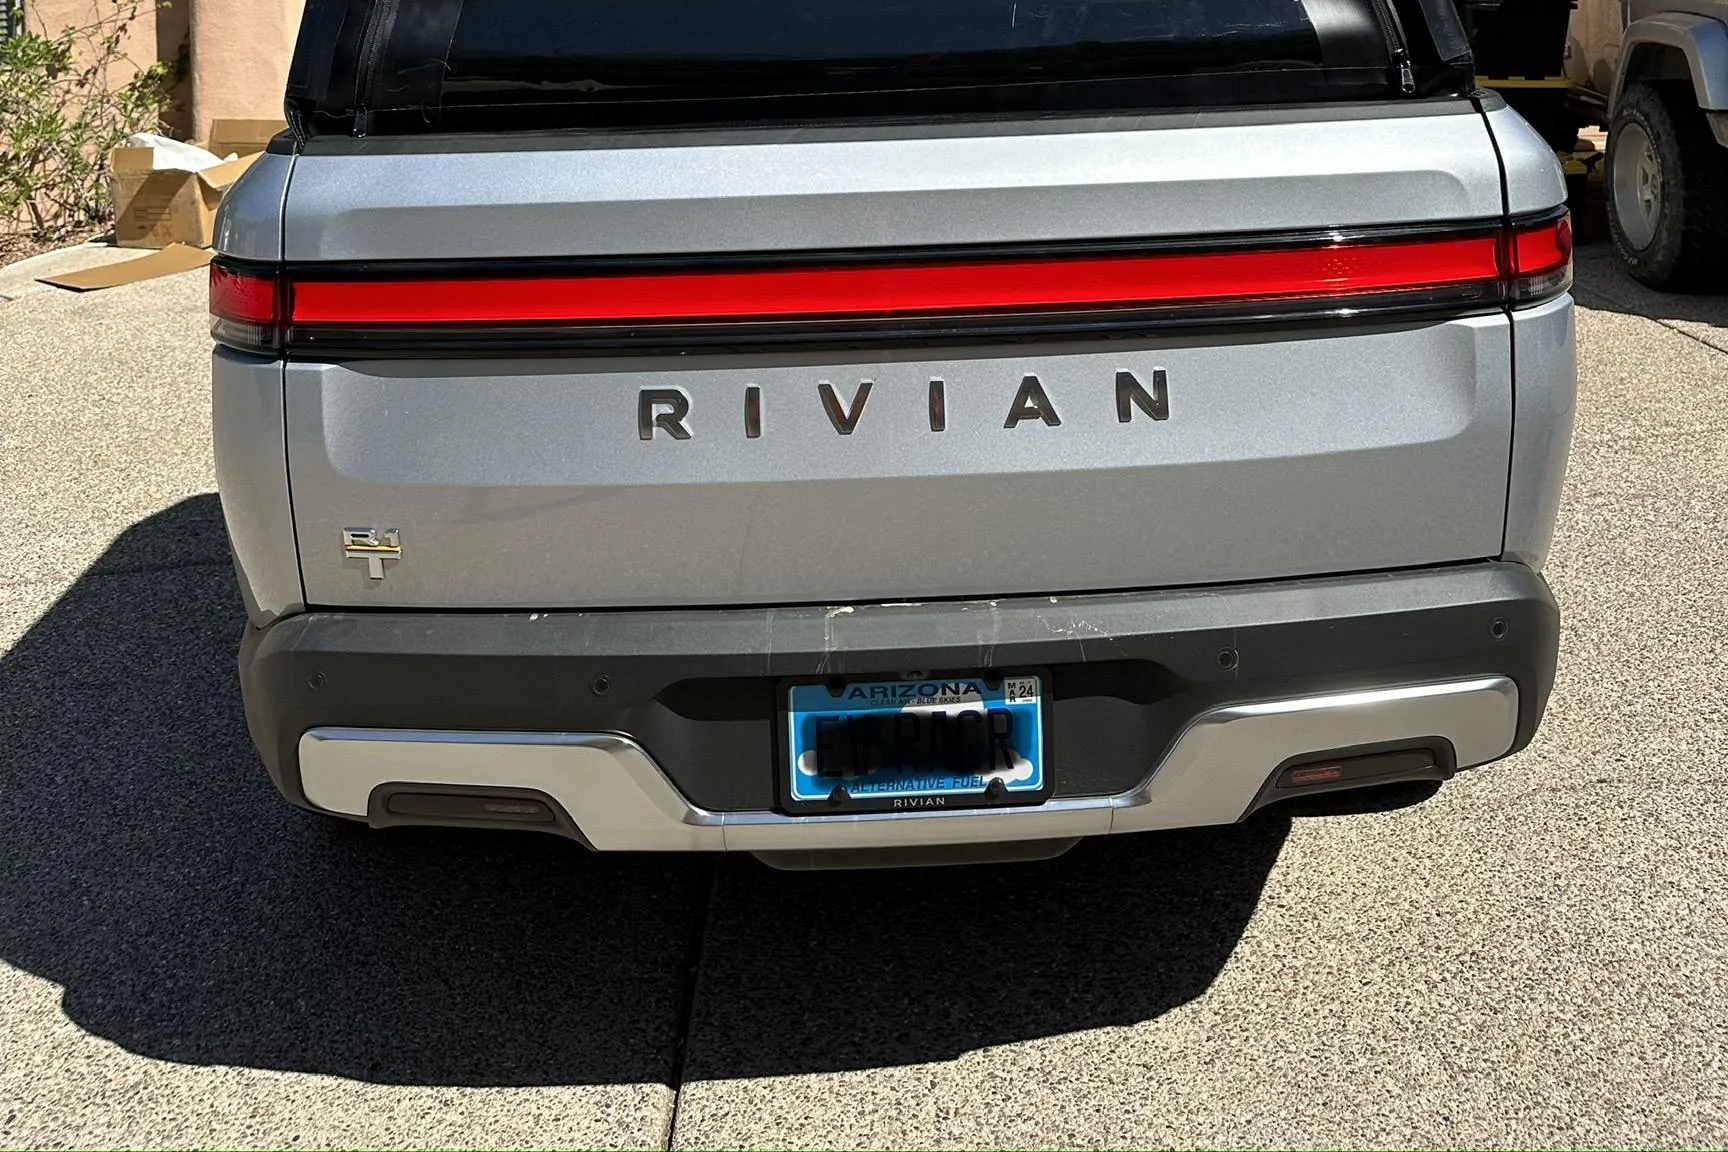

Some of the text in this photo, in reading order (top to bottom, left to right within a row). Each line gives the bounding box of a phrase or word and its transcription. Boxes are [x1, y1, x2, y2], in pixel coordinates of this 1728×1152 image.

[637, 367, 1171, 441] RIVIAN
[848, 681, 983, 700] ARIZONA
[1018, 684, 1034, 698] 24
[916, 697, 938, 705] BLUE
[938, 696, 961, 704] SKIES
[850, 775, 989, 793] ALTERNATIVE FUEL
[893, 796, 945, 808] RIVIAN
